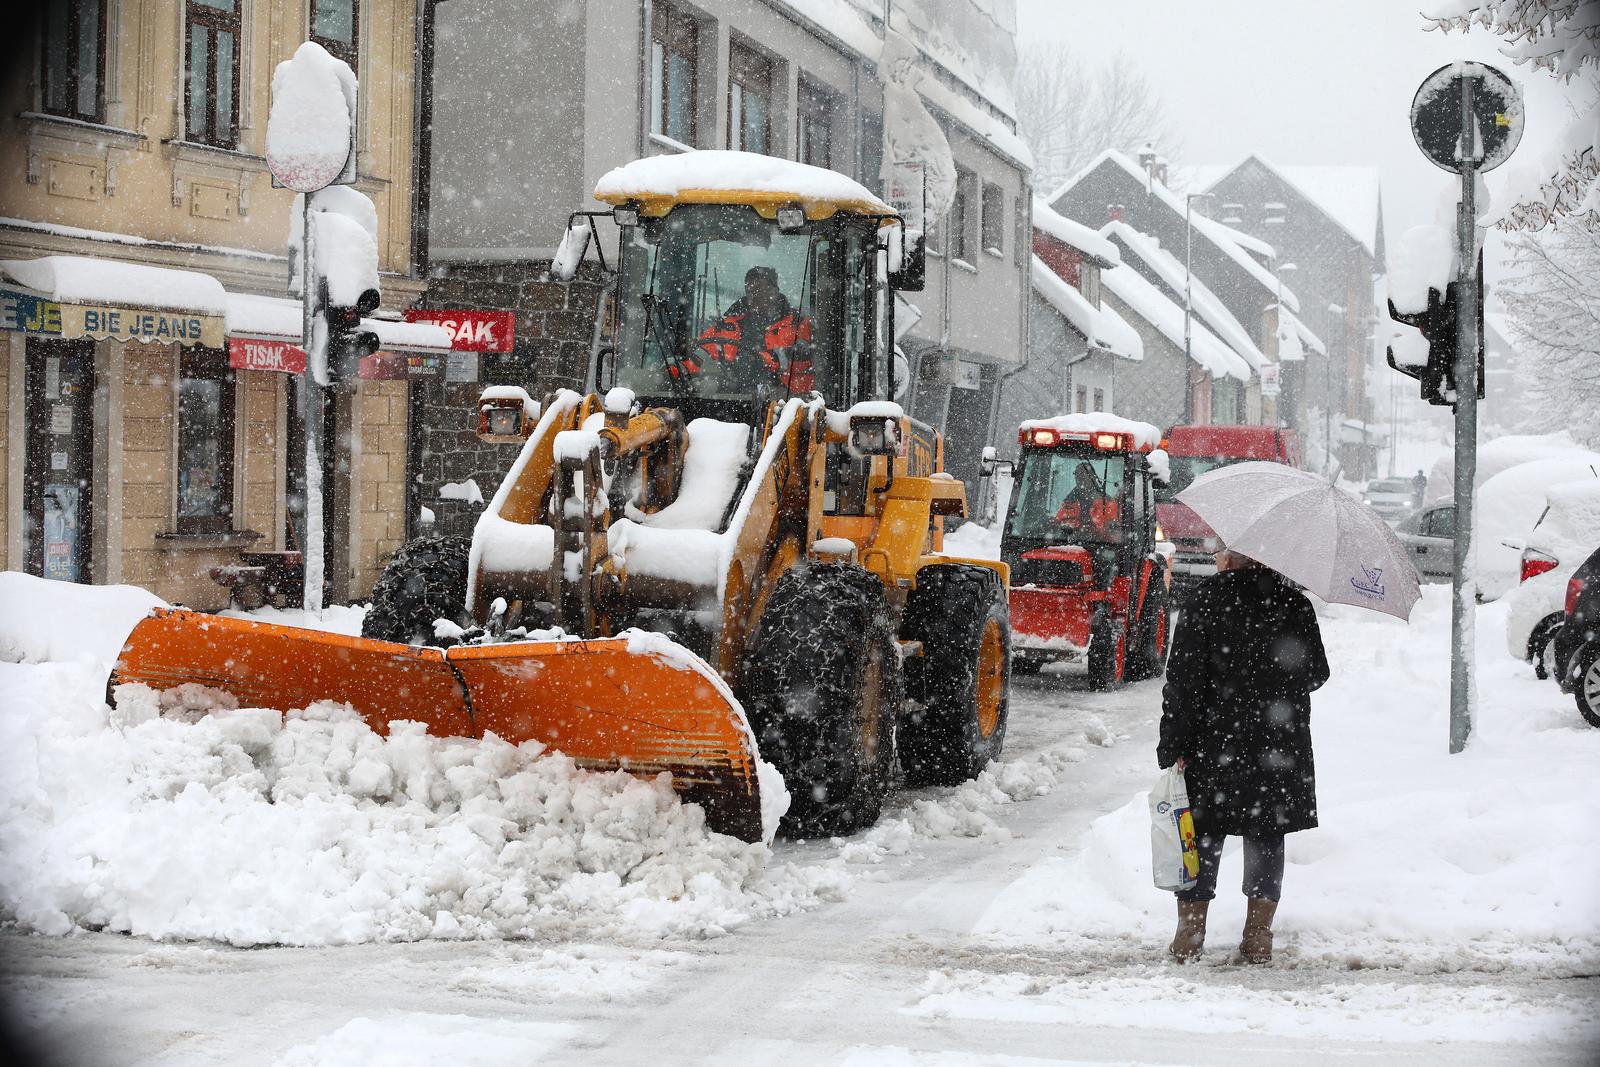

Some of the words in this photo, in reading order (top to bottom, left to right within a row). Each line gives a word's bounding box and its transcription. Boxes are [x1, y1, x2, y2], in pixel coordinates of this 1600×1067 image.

[84, 310, 121, 334] BIE
[129, 314, 202, 339] JEANS
[244, 344, 284, 368] TISAK
